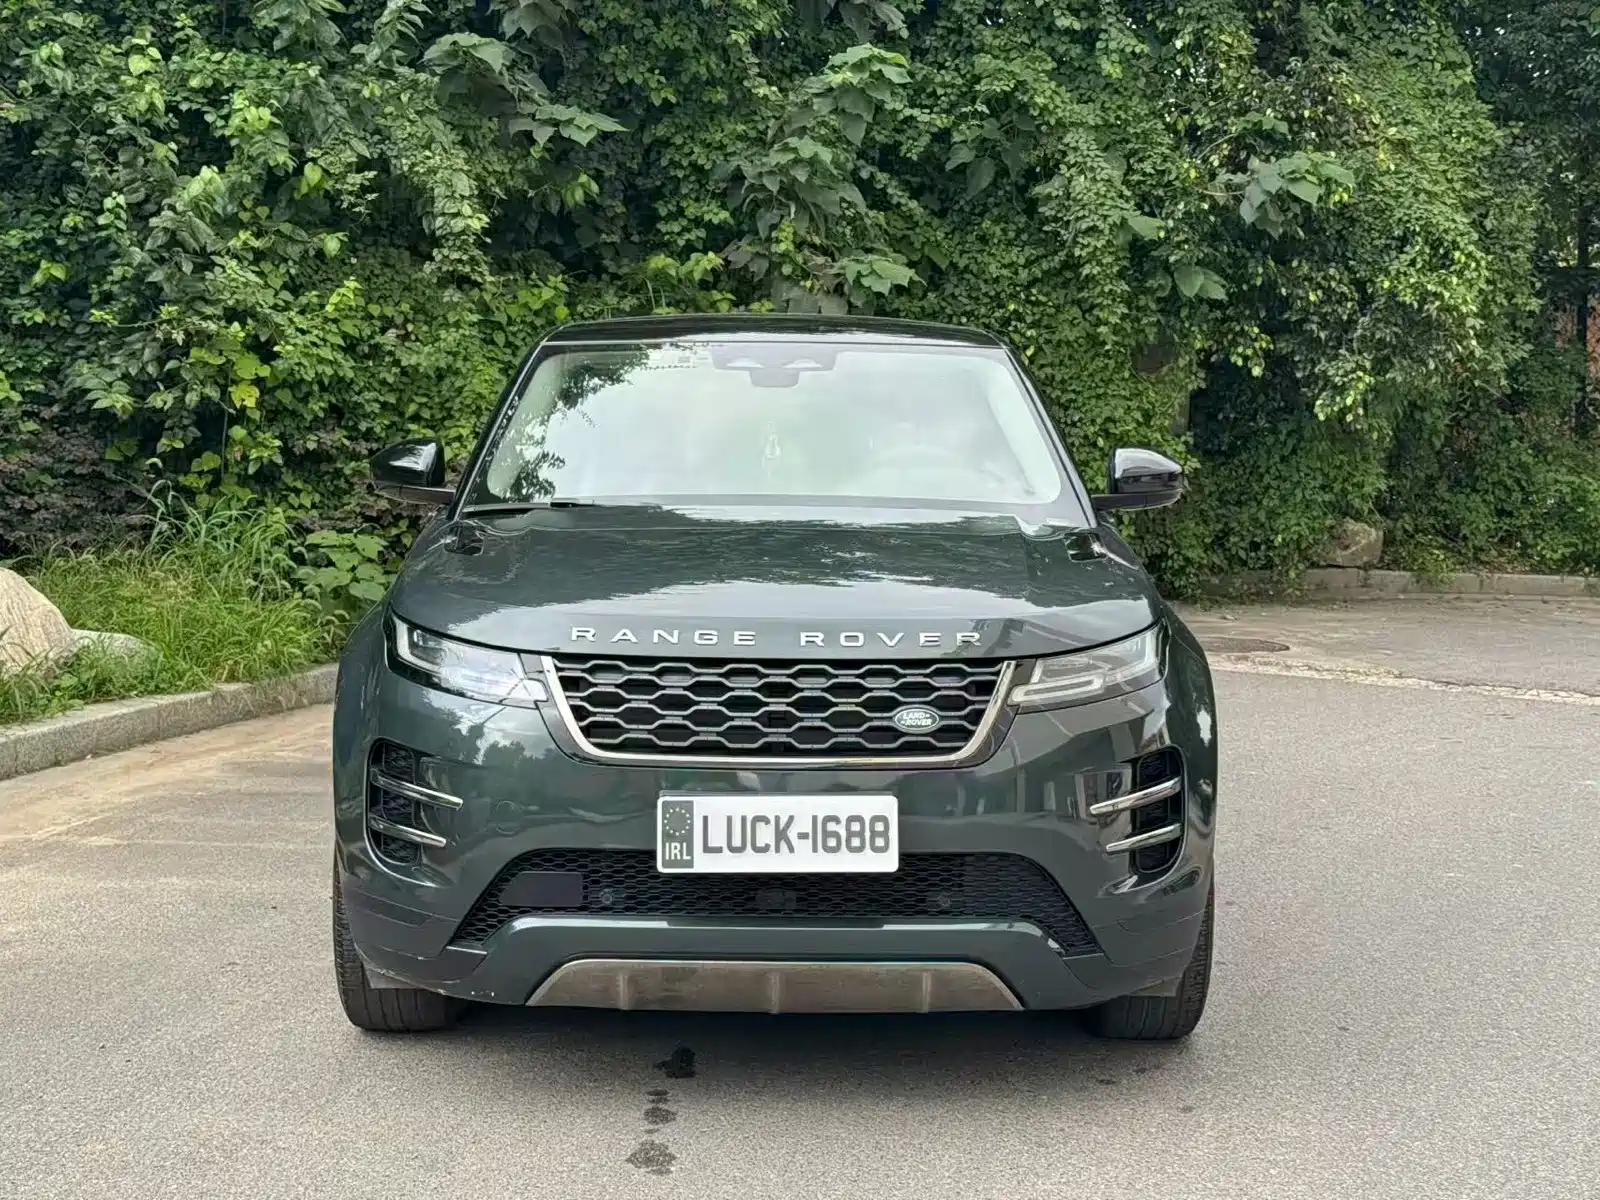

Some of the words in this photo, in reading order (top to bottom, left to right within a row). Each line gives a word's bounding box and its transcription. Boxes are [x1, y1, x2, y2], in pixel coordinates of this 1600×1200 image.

[571, 626, 756, 647] RANGE
[800, 631, 983, 648] ROVER
[702, 815, 890, 854] LUCK-1688
[665, 842, 691, 860] IRL
